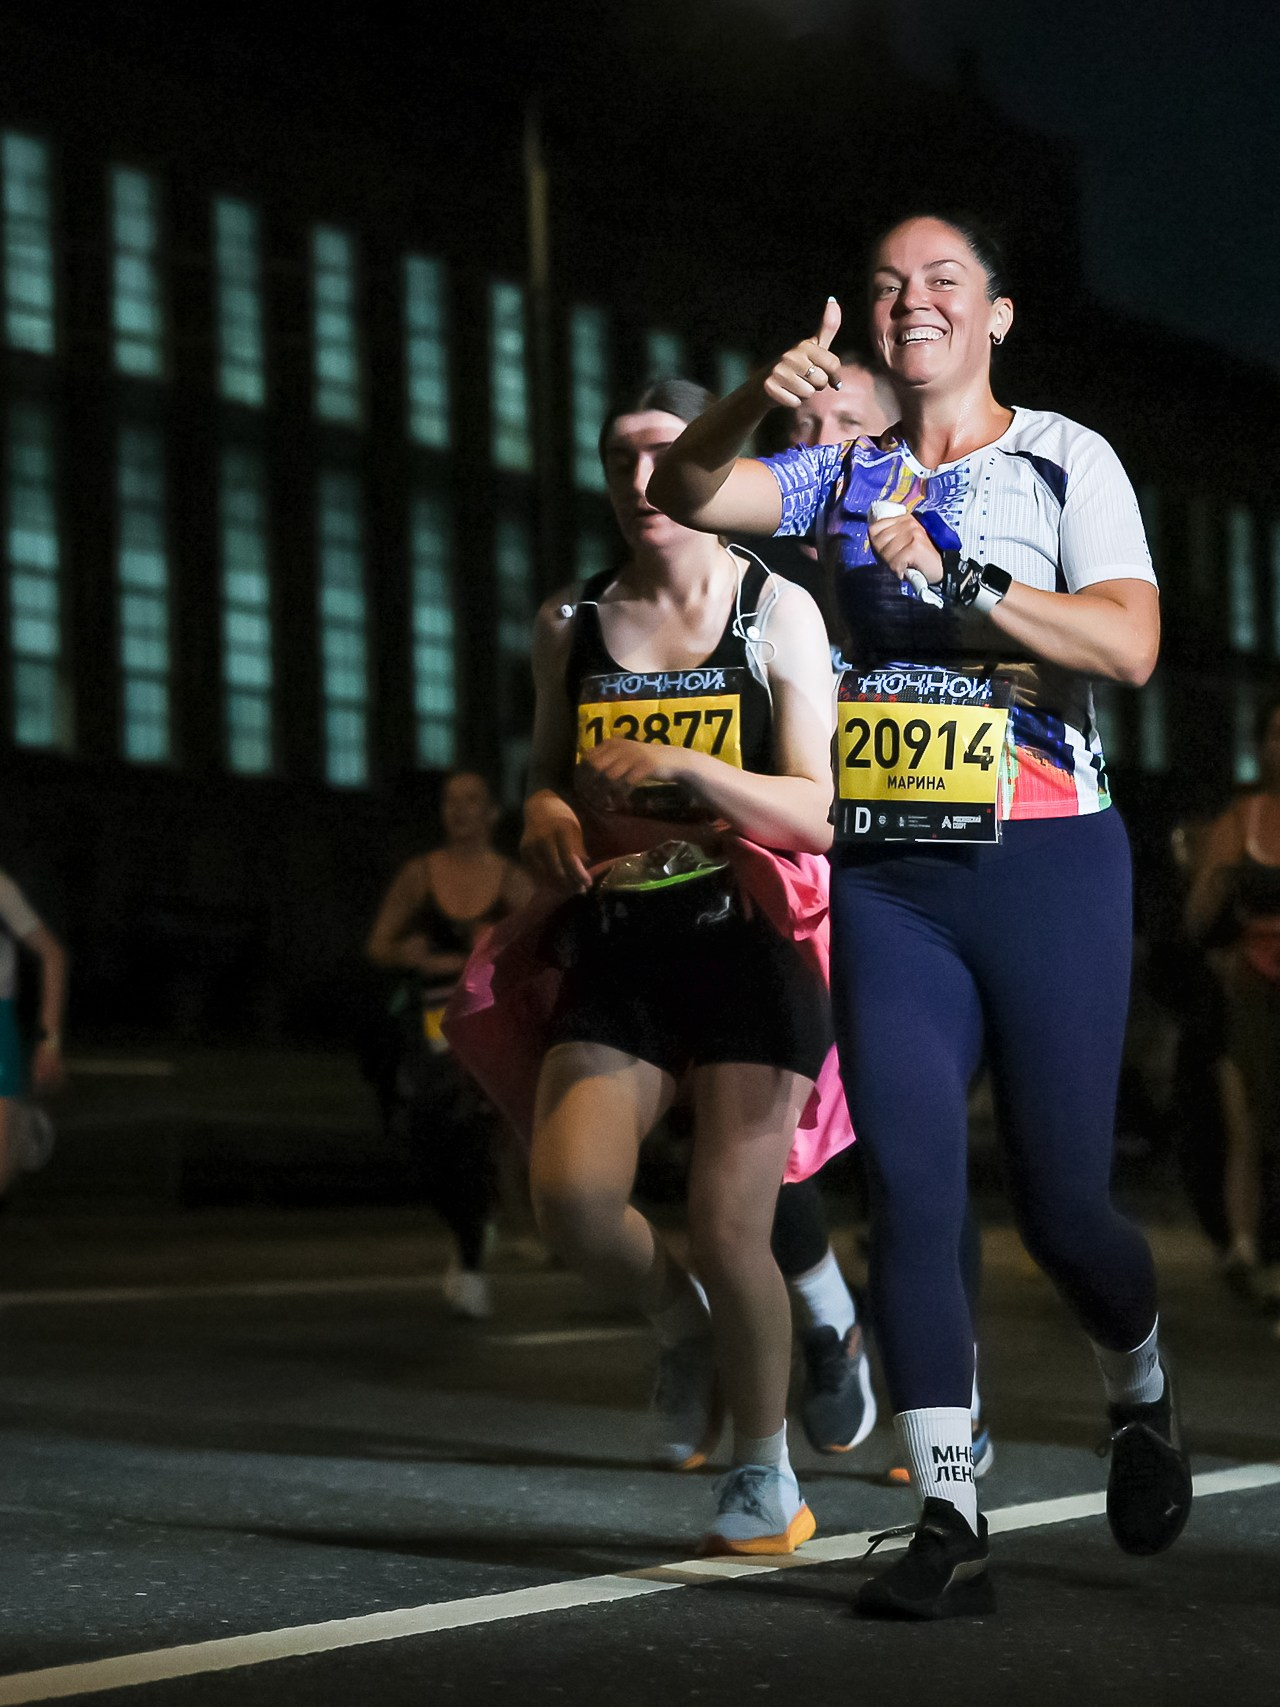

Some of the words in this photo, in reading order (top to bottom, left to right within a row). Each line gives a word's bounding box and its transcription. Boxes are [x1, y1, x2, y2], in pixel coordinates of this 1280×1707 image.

[585, 708, 733, 756] 13877
[844, 717, 995, 771] 20914
[887, 775, 946, 791] МАРИНА
[854, 806, 872, 834] D
[934, 1465, 975, 1483] ЛЕН
